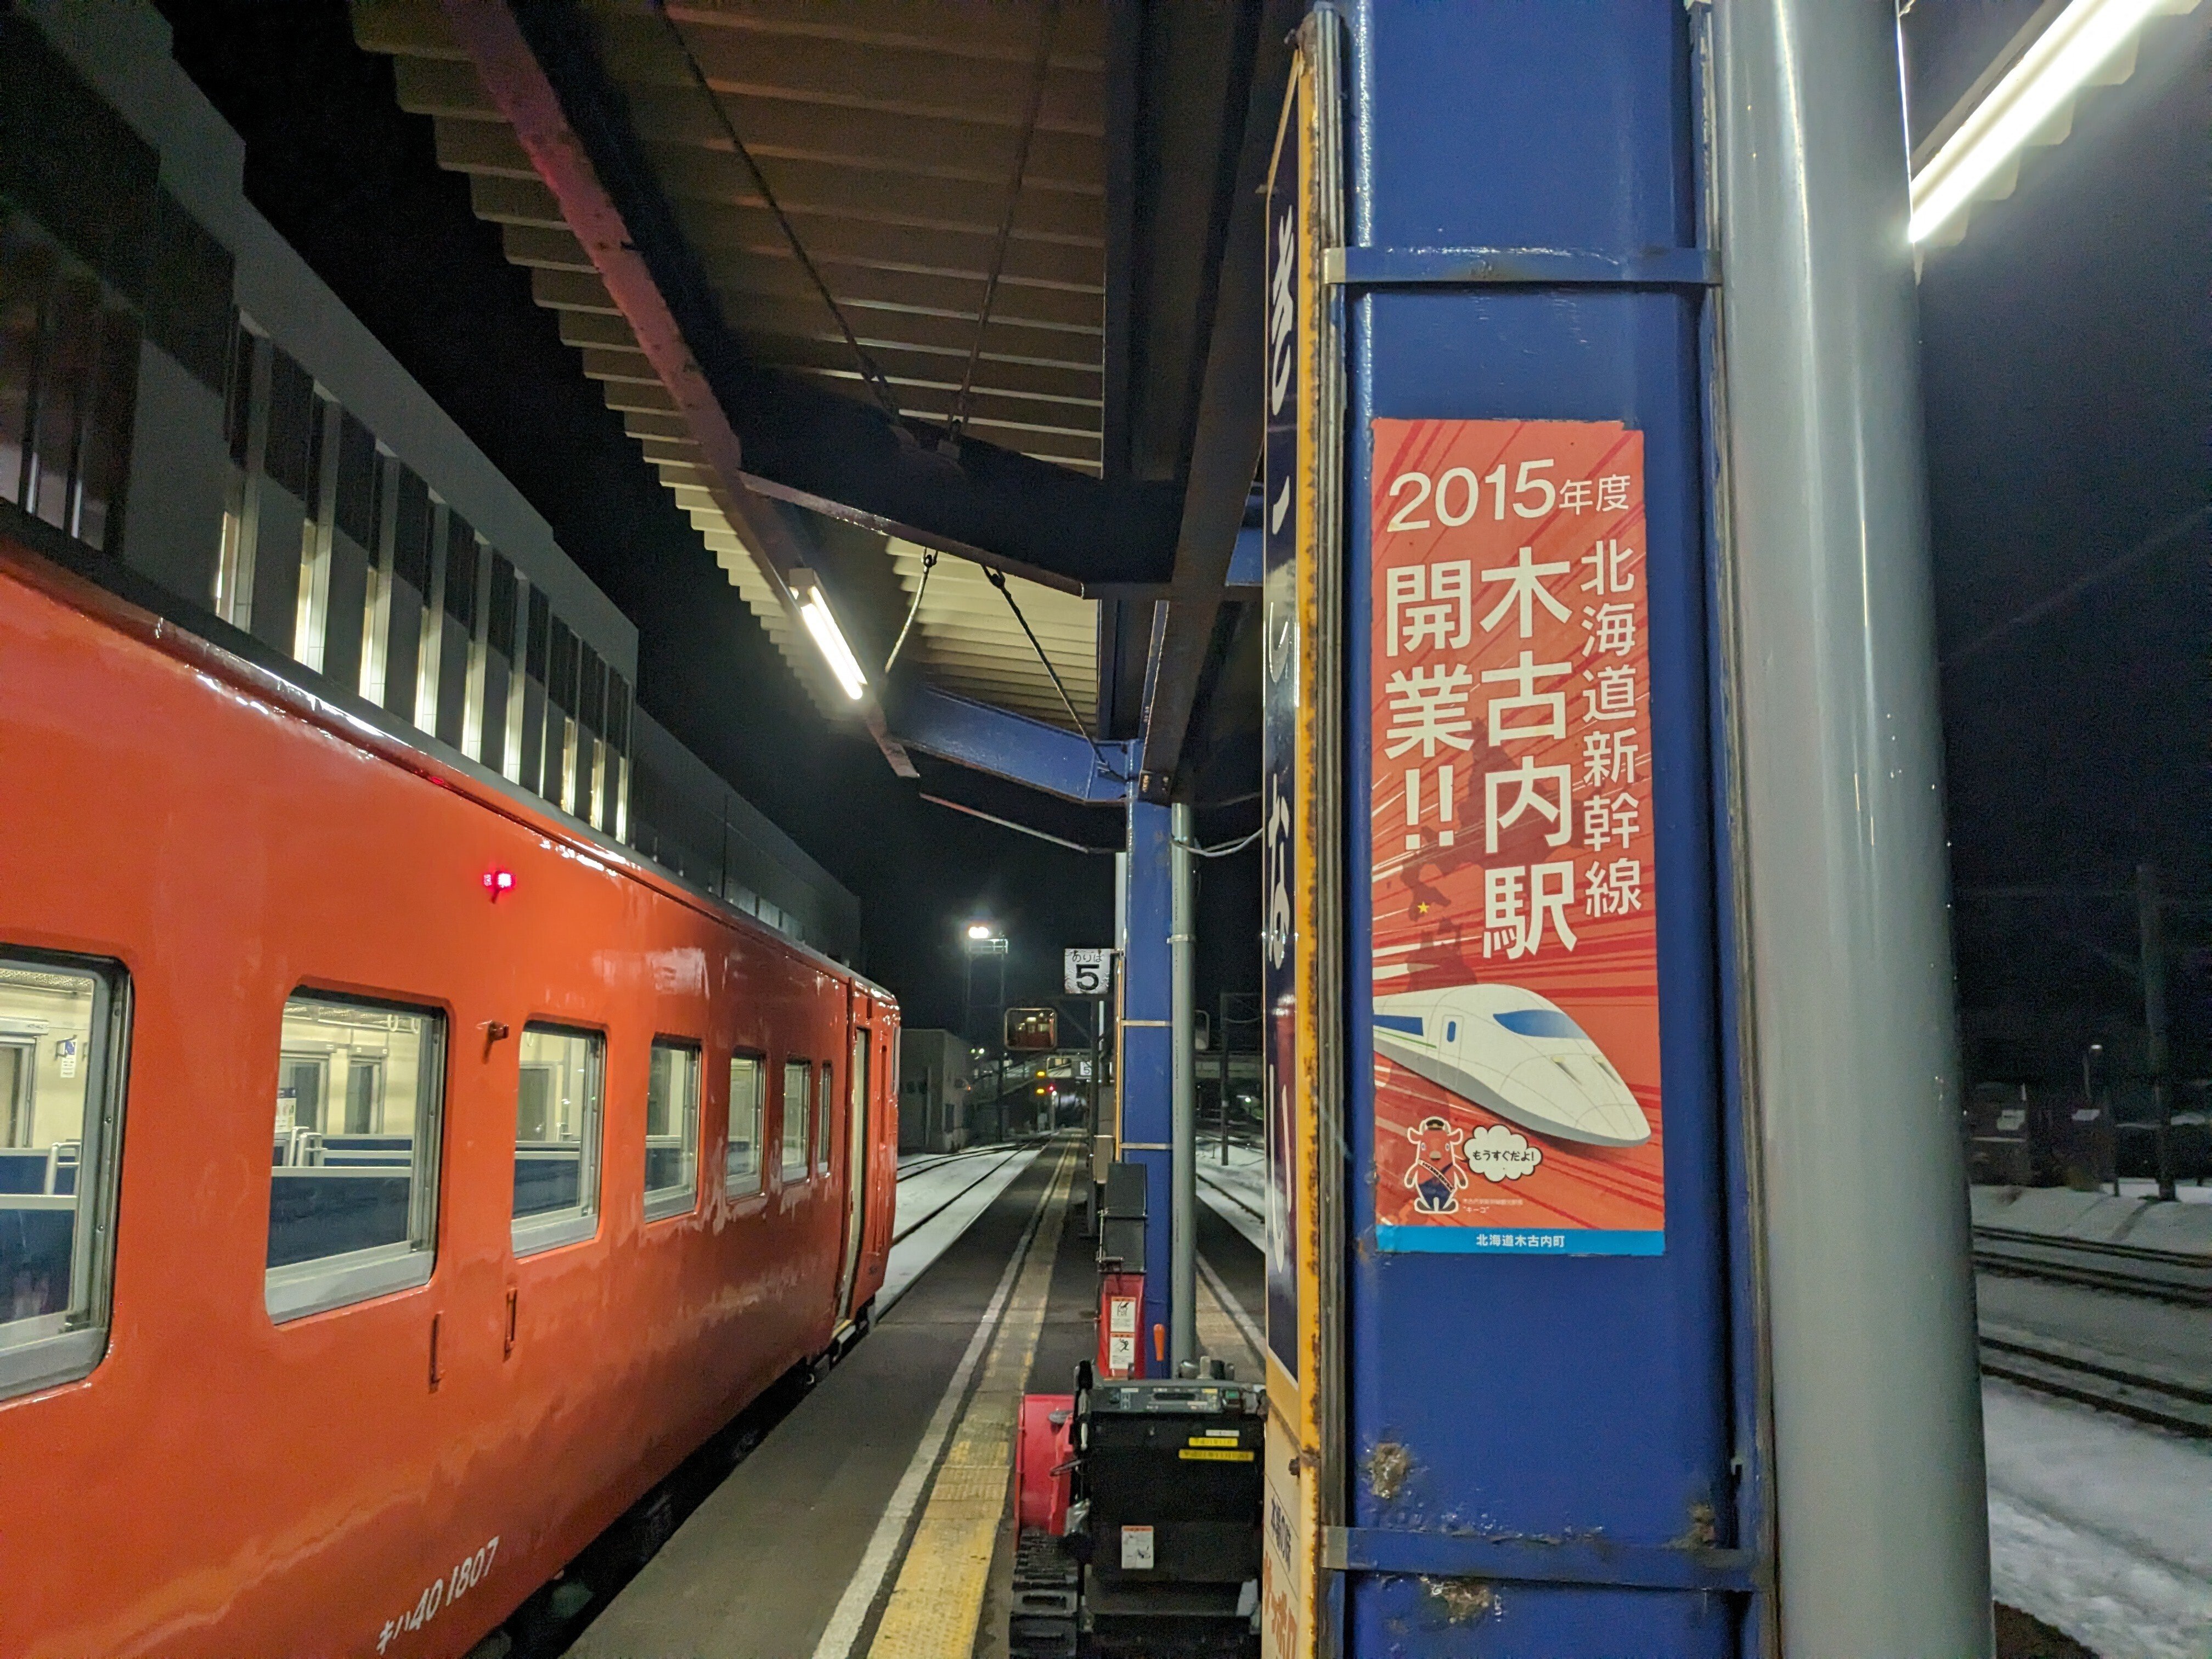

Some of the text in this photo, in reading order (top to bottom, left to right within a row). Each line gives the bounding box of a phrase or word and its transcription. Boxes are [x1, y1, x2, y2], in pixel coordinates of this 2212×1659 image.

[1386, 459, 1631, 532] 2015年度
[1479, 546, 1577, 960] 木古内駅
[1580, 539, 1642, 917] 北海道新幹線
[1072, 952, 1103, 962] のりば
[1075, 964, 1099, 990] 5
[1476, 1234, 1565, 1248] 北海道木古内町
[376, 1536, 500, 1655] キハ40 1807
